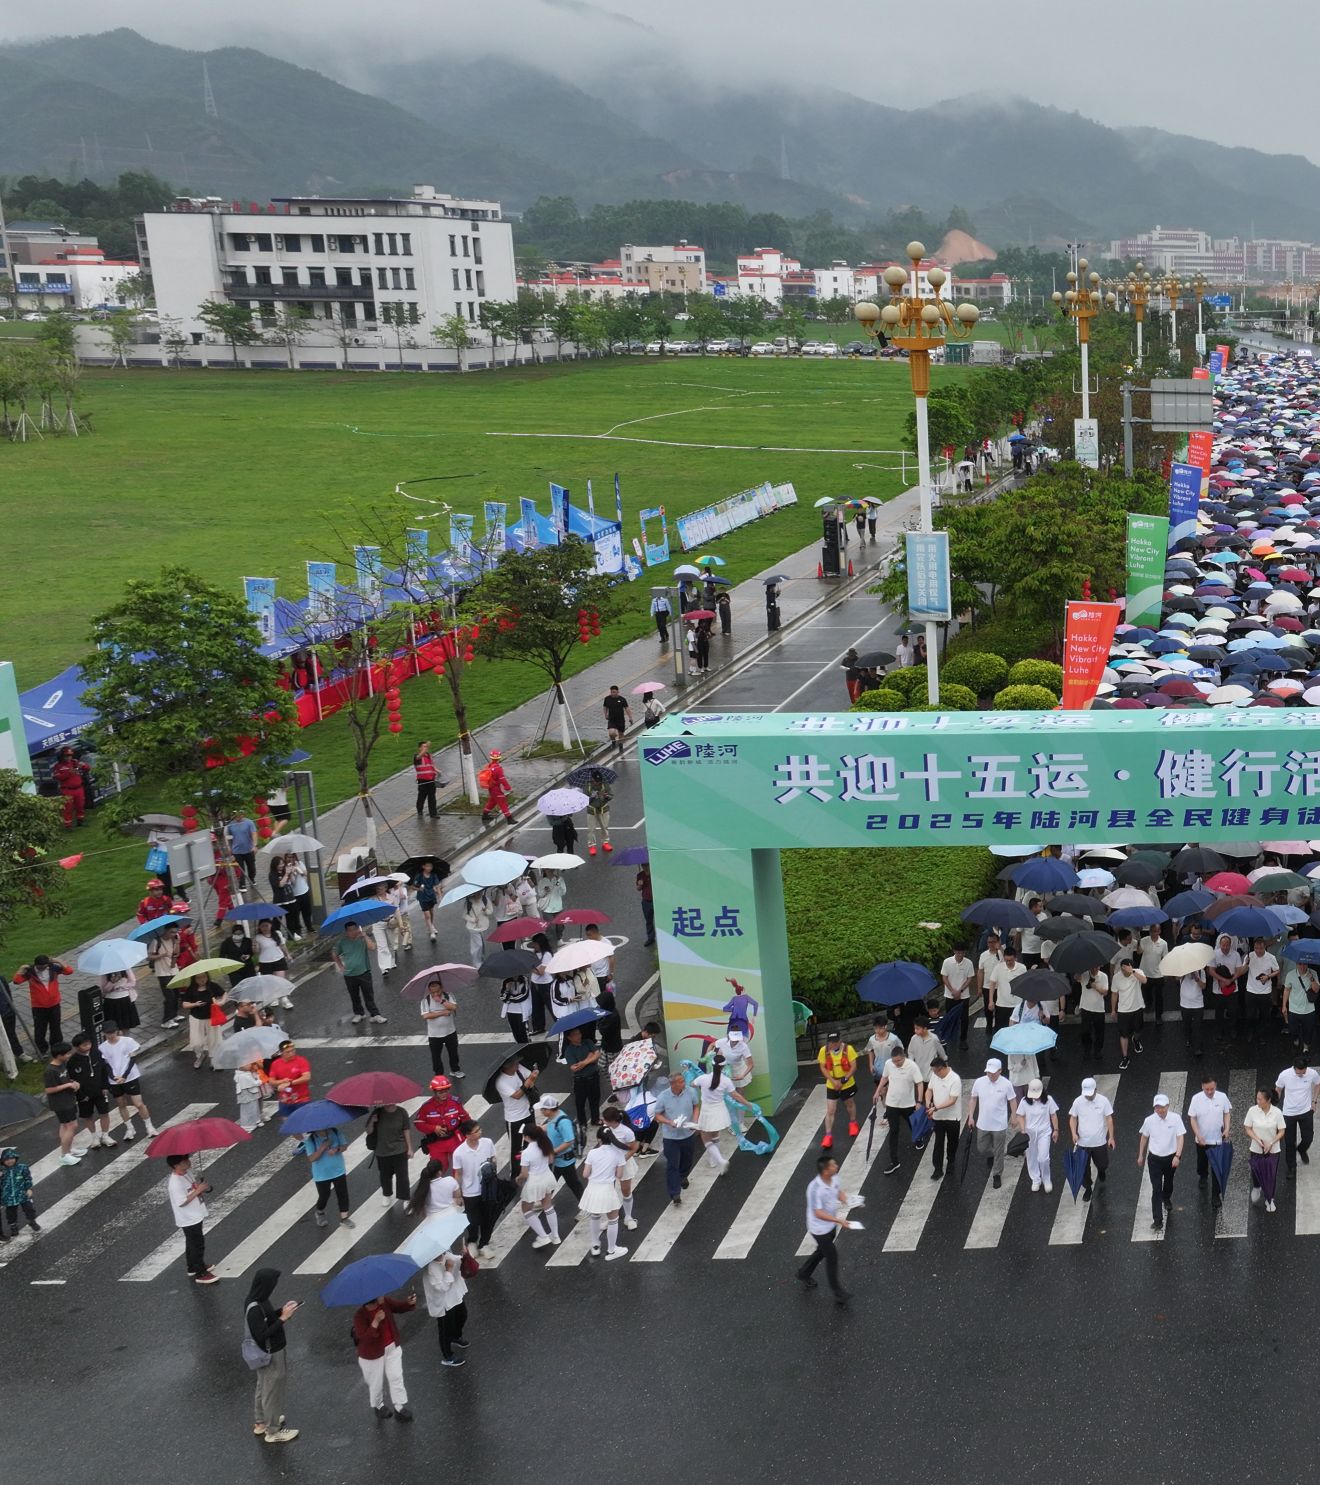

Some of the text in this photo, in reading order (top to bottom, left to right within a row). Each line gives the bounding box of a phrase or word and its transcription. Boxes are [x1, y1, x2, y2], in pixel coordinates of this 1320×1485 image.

[1185, 489, 1195, 497] City
[1131, 538, 1151, 546] Hakka
[1130, 545, 1159, 555] New City
[1130, 553, 1153, 562] Vibrant
[1129, 560, 1144, 568] Luhe
[1071, 633, 1097, 643] Hakka
[1070, 644, 1107, 655] New City
[1069, 665, 1089, 674] Luhe
[648, 740, 738, 765] LUHE 陸河
[671, 905, 744, 938] 起点
